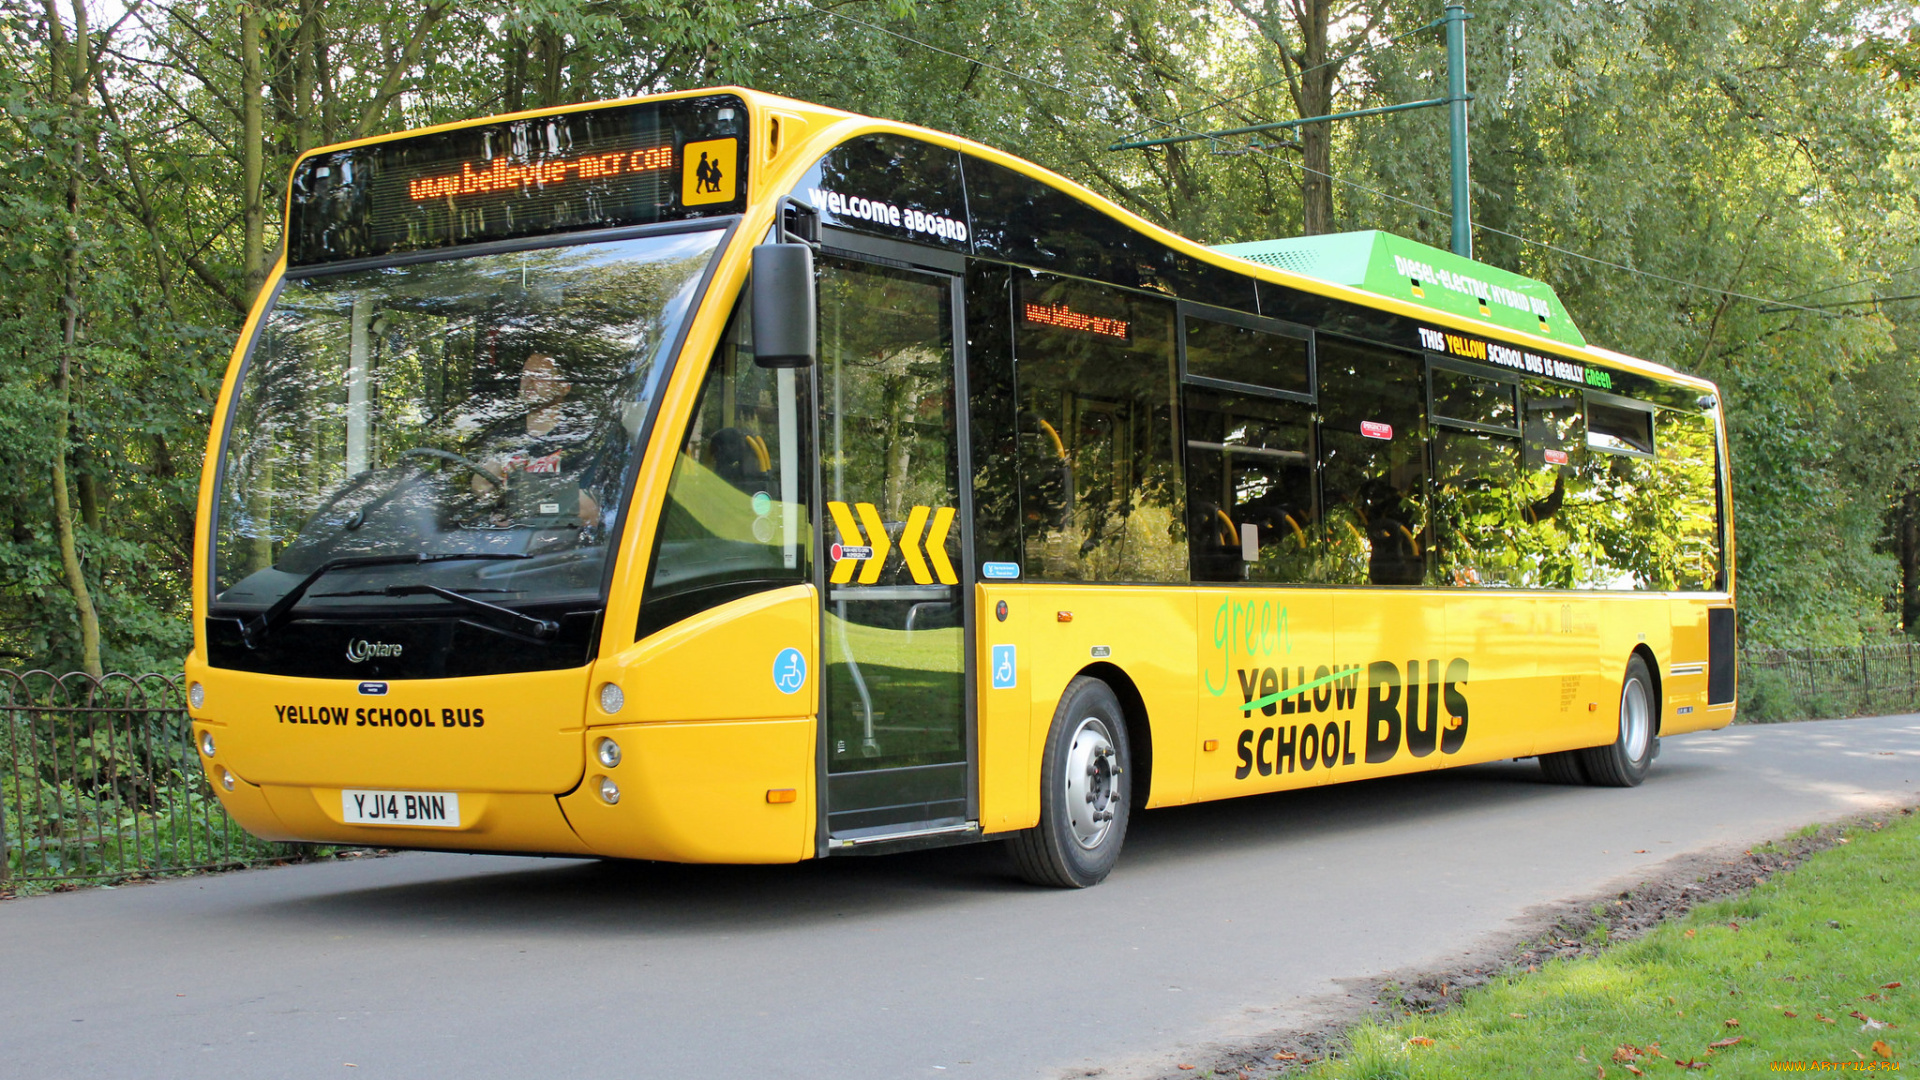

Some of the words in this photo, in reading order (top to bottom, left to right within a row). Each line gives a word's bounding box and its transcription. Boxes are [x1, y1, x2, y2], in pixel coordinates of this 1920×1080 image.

[1490, 284, 1530, 312] HYBRID
[1529, 296, 1551, 318] BUS
[1418, 327, 1446, 352] THIS
[1487, 343, 1525, 370] SCHOOL
[1524, 353, 1544, 374] BUS
[1543, 357, 1554, 377] IS
[351, 639, 403, 662] Optare
[1205, 595, 1294, 697] green
[355, 707, 436, 728] SCHOOL
[441, 708, 485, 728] BUS
[1364, 657, 1470, 764] BUS
[1234, 719, 1356, 781] SCHOOL
[354, 794, 399, 820] YJ14
[404, 795, 446, 821] BNN
